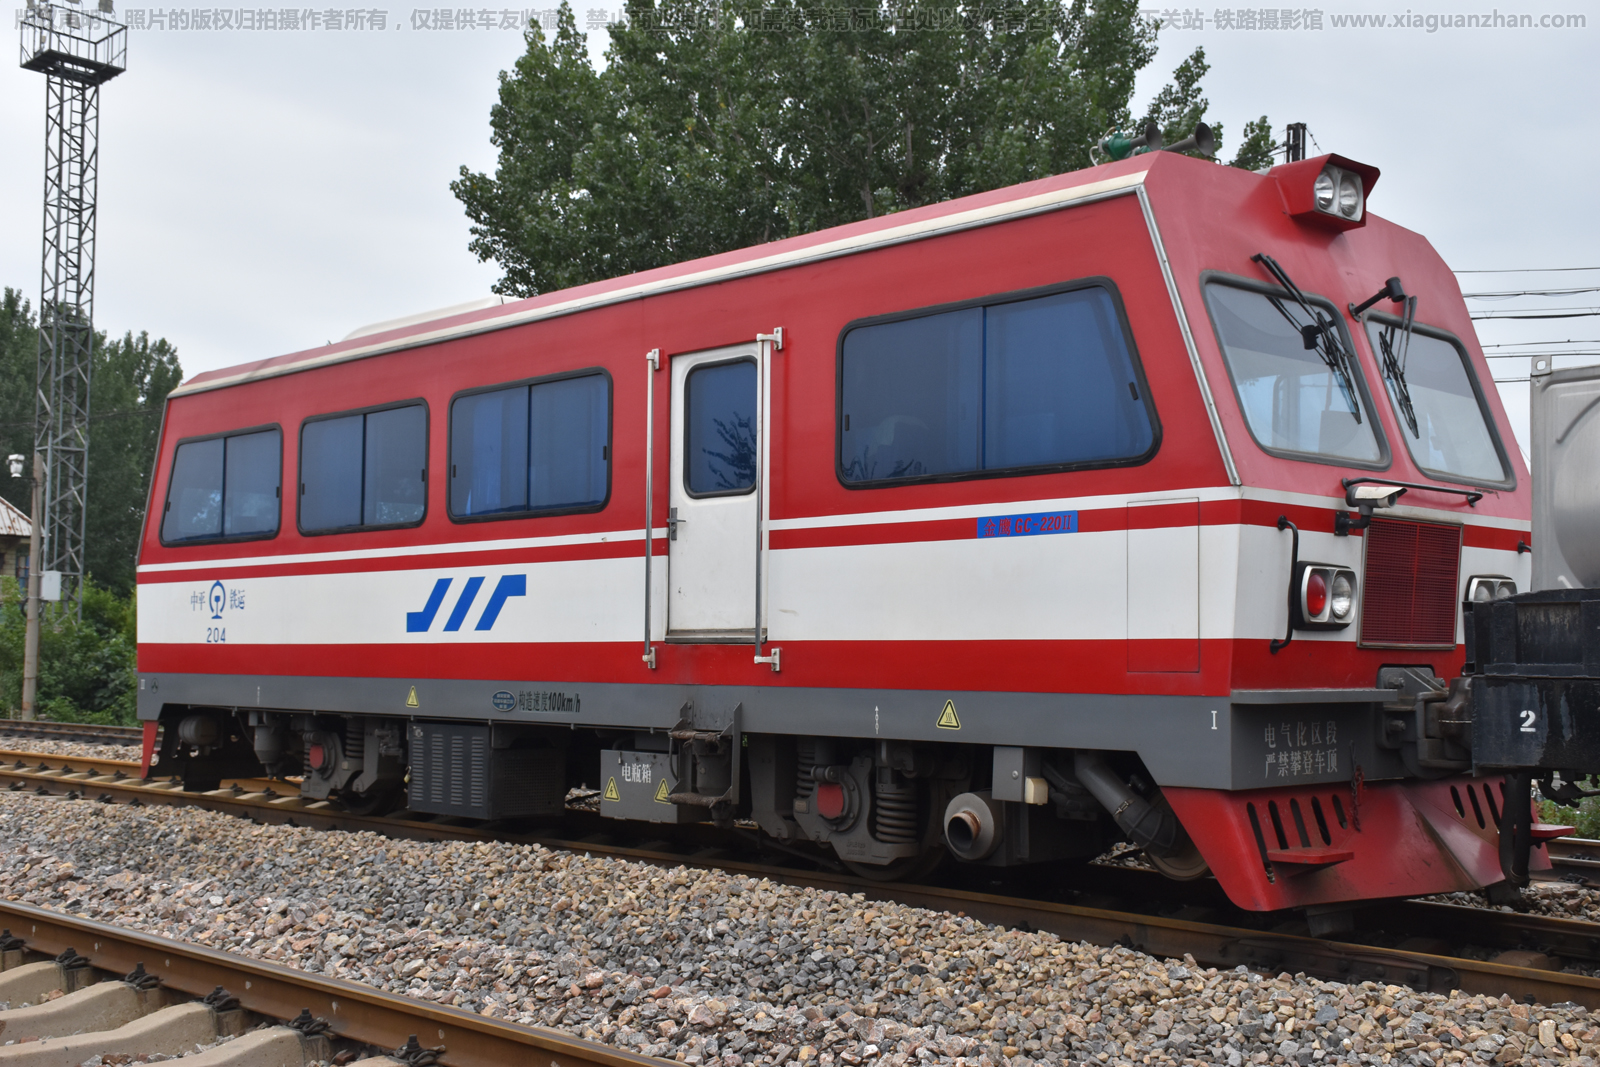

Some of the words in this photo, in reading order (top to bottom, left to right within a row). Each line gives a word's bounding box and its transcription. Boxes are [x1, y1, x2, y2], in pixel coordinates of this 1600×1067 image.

[206, 627, 226, 643] 204
[1519, 710, 1536, 732] 2
[1264, 720, 1337, 749] 电气化区段
[621, 762, 652, 784] 电瓶箱
[1264, 748, 1338, 779] 严禁攀登车顶
